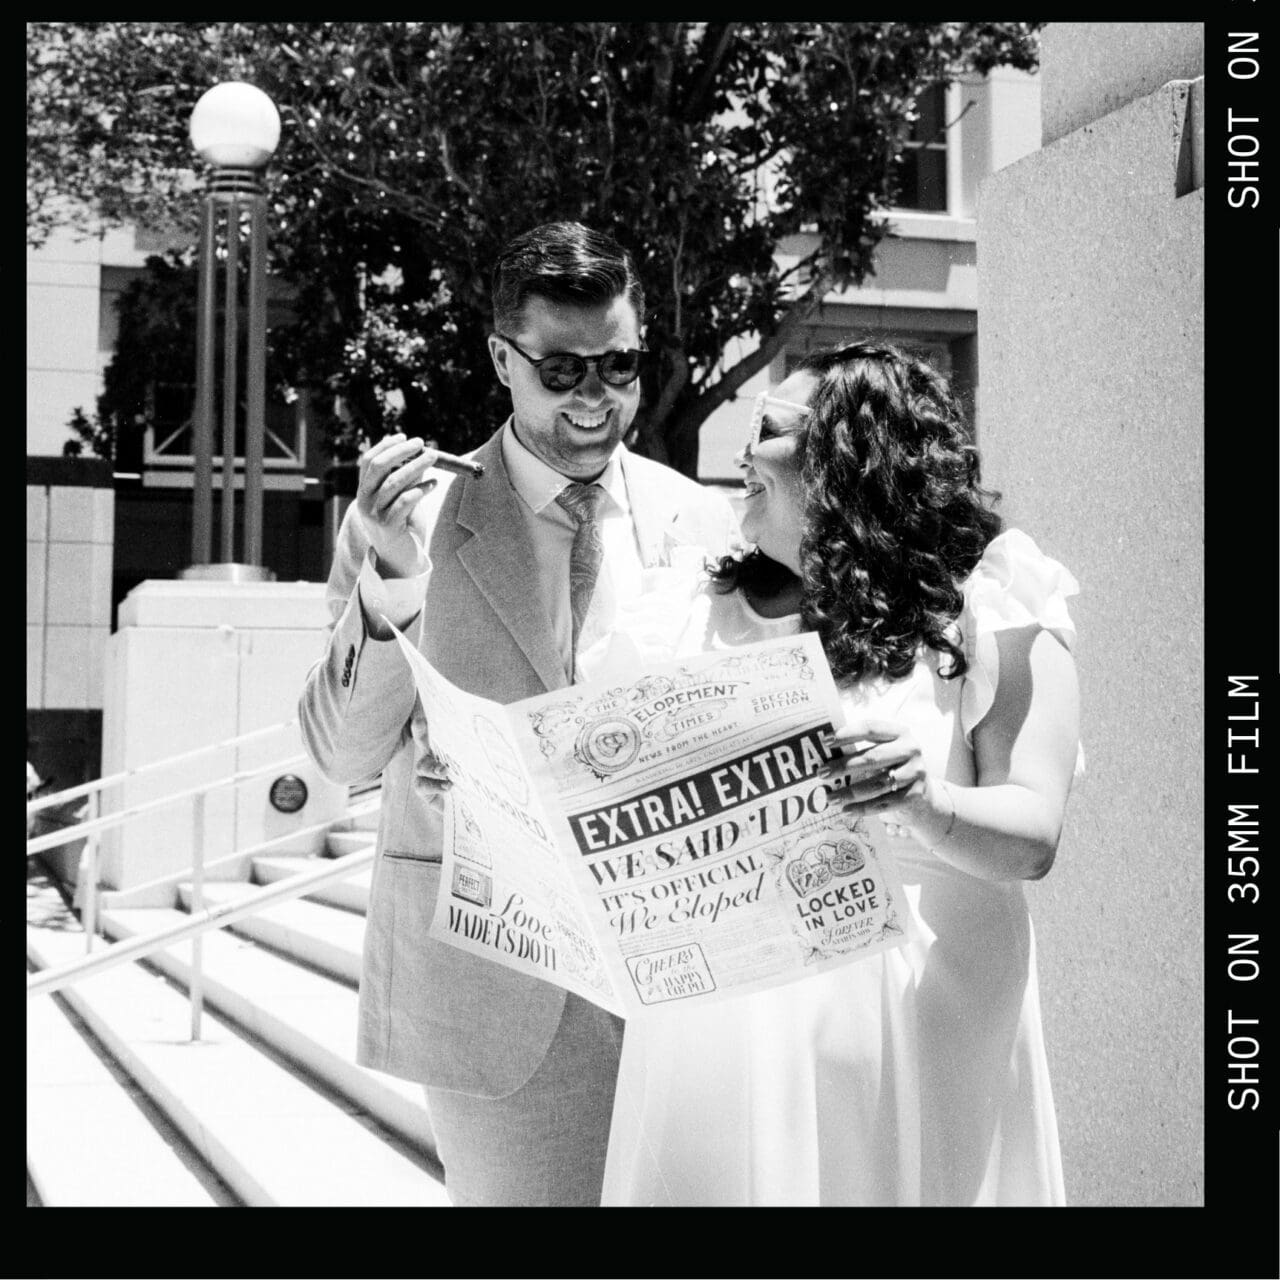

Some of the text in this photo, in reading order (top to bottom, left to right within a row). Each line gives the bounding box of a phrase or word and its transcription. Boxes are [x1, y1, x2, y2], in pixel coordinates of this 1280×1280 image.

[595, 701, 618, 714] THE
[634, 684, 739, 724] ELOPEMENT
[752, 689, 809, 706] SPECIAL
[754, 695, 810, 714] EDITION
[672, 711, 715, 732] TIMES
[638, 722, 739, 764] NEWS FROM THE HEART
[577, 781, 703, 851] EXTRA!
[588, 847, 647, 886] WE
[655, 820, 740, 870] SAID
[651, 854, 764, 900] OFFICIAL
[610, 907, 658, 937] We
[667, 871, 766, 923] Eloped
[797, 878, 876, 918] LOCKED
[805, 896, 879, 931] IN LOVE
[449, 905, 493, 946] MADE
[517, 932, 541, 964] DO
